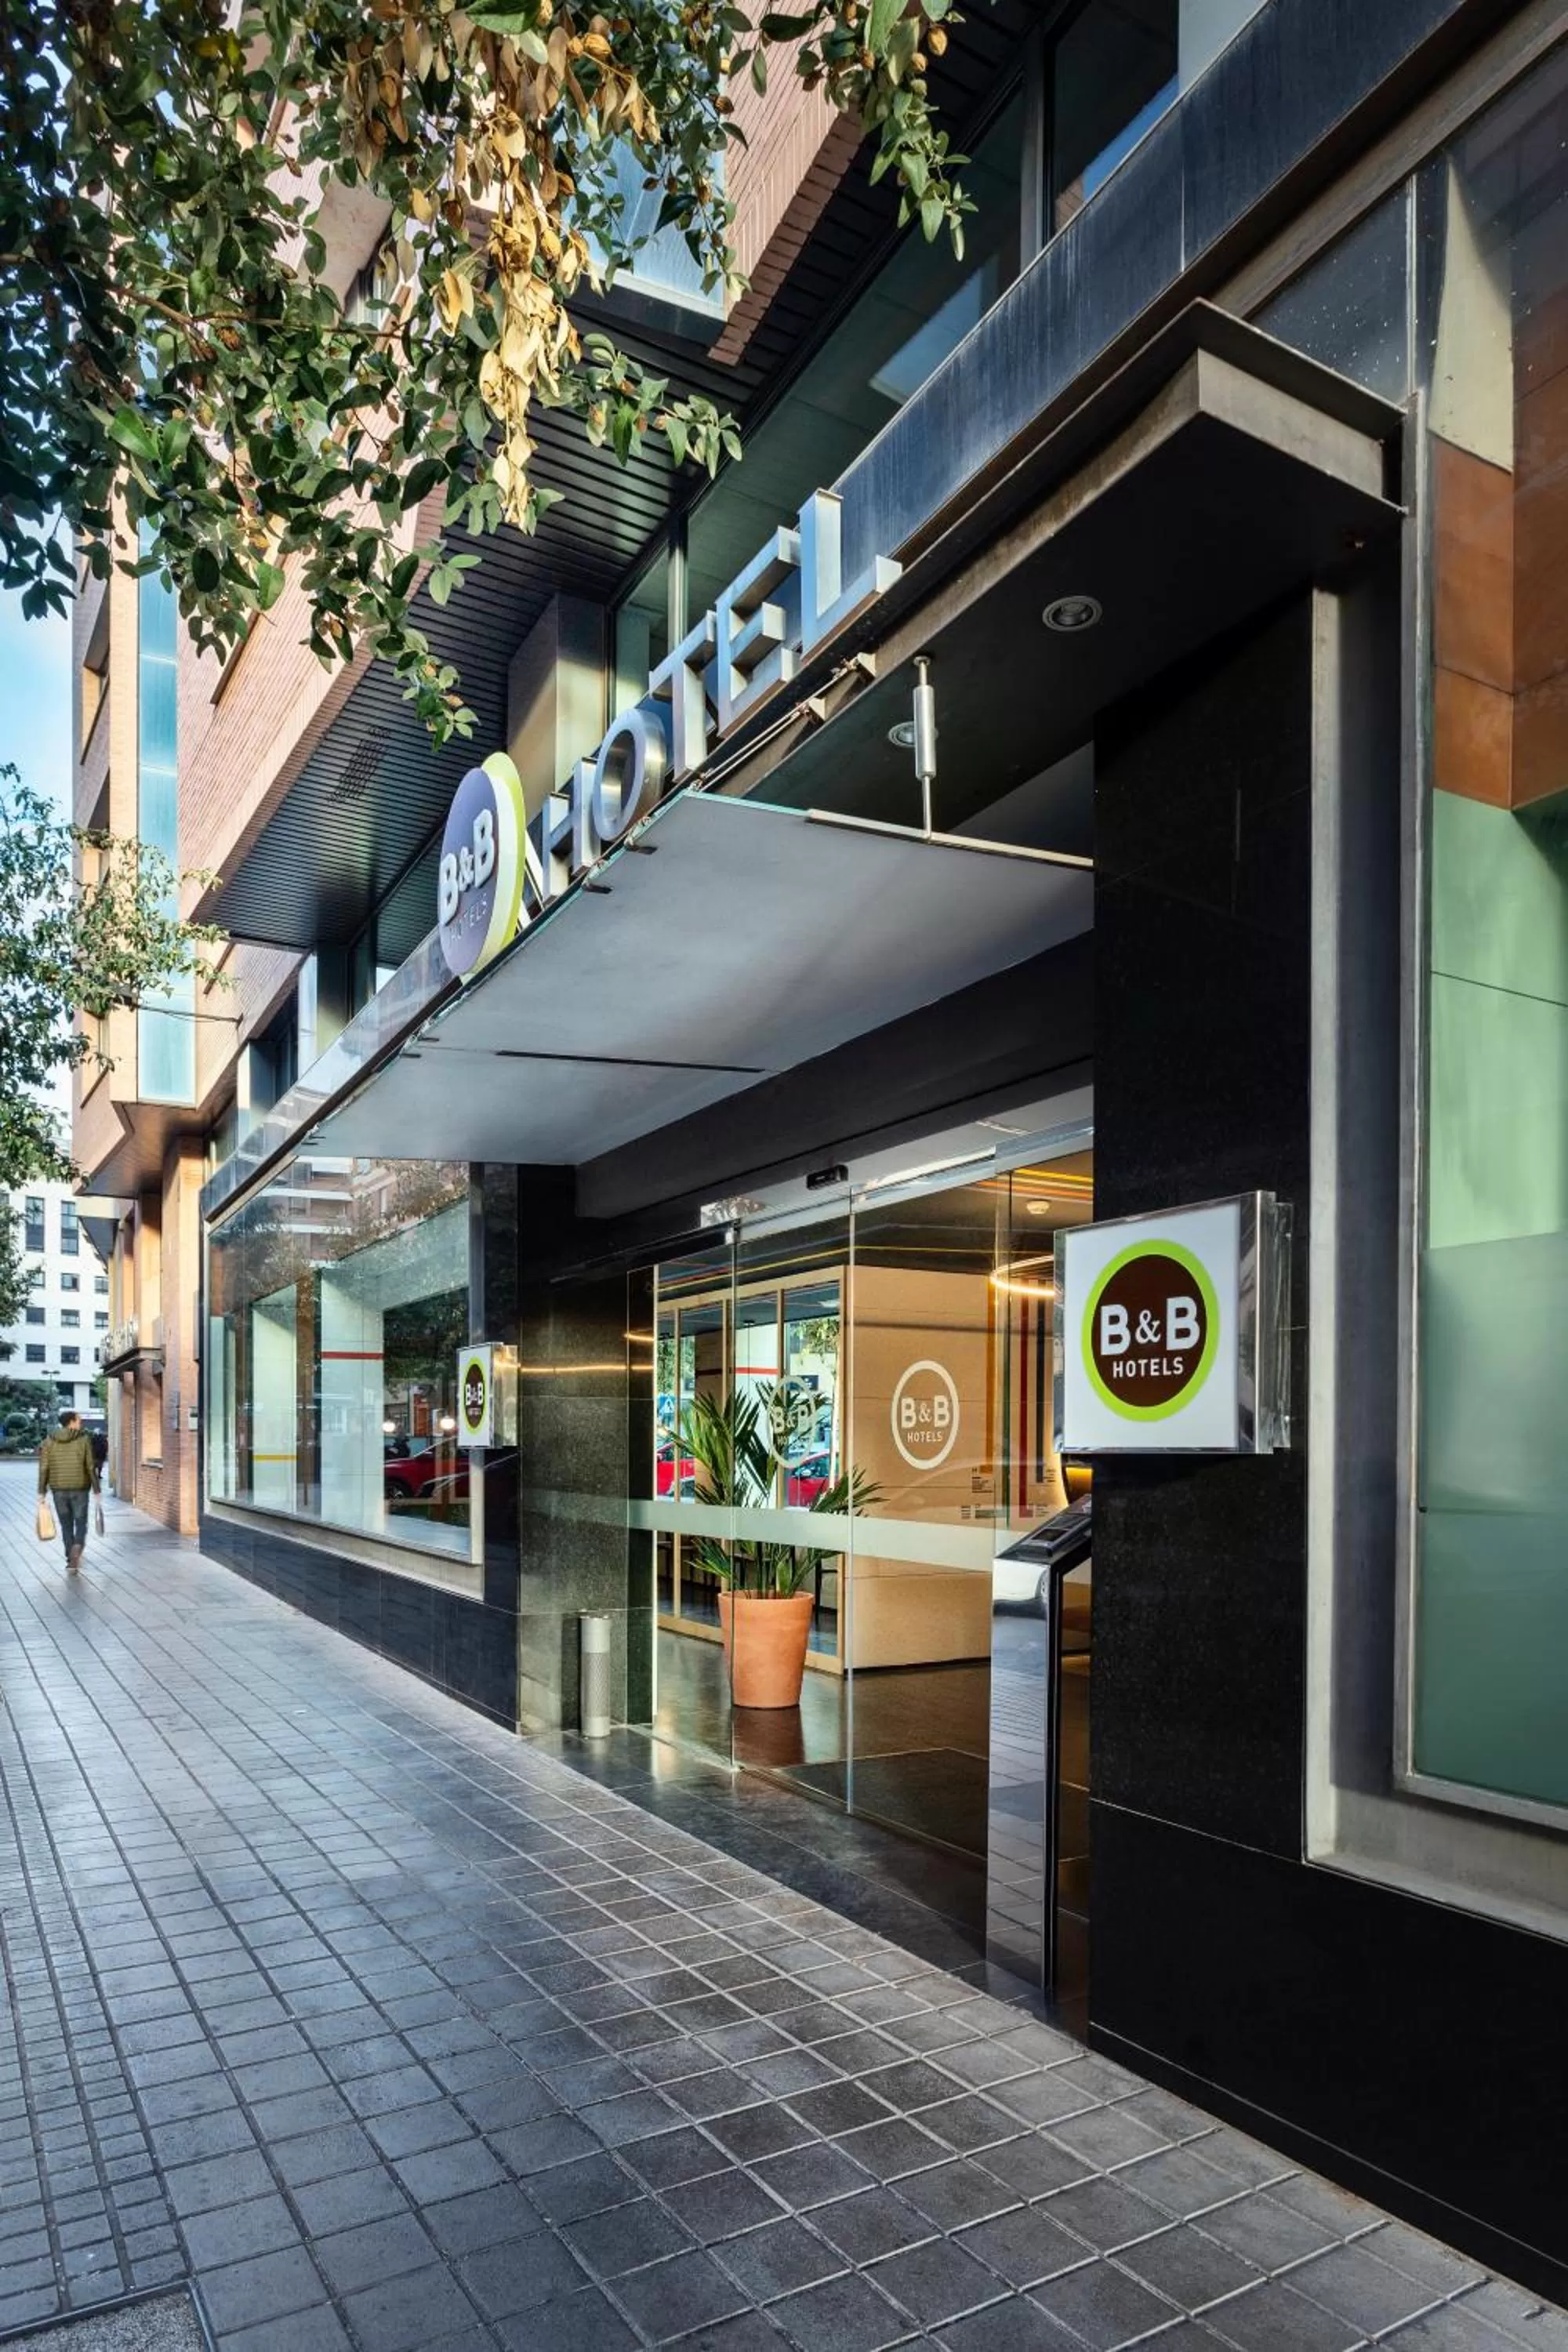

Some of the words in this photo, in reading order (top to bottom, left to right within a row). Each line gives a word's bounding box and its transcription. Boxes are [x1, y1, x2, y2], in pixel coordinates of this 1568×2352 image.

[542, 487, 903, 910] HOTEL
[439, 809, 495, 926] B&B
[1100, 1296, 1201, 1356] B&B
[1112, 1357, 1184, 1378] HOTELS
[901, 1395, 950, 1428] B&B
[907, 1431, 944, 1443] HOTELS
